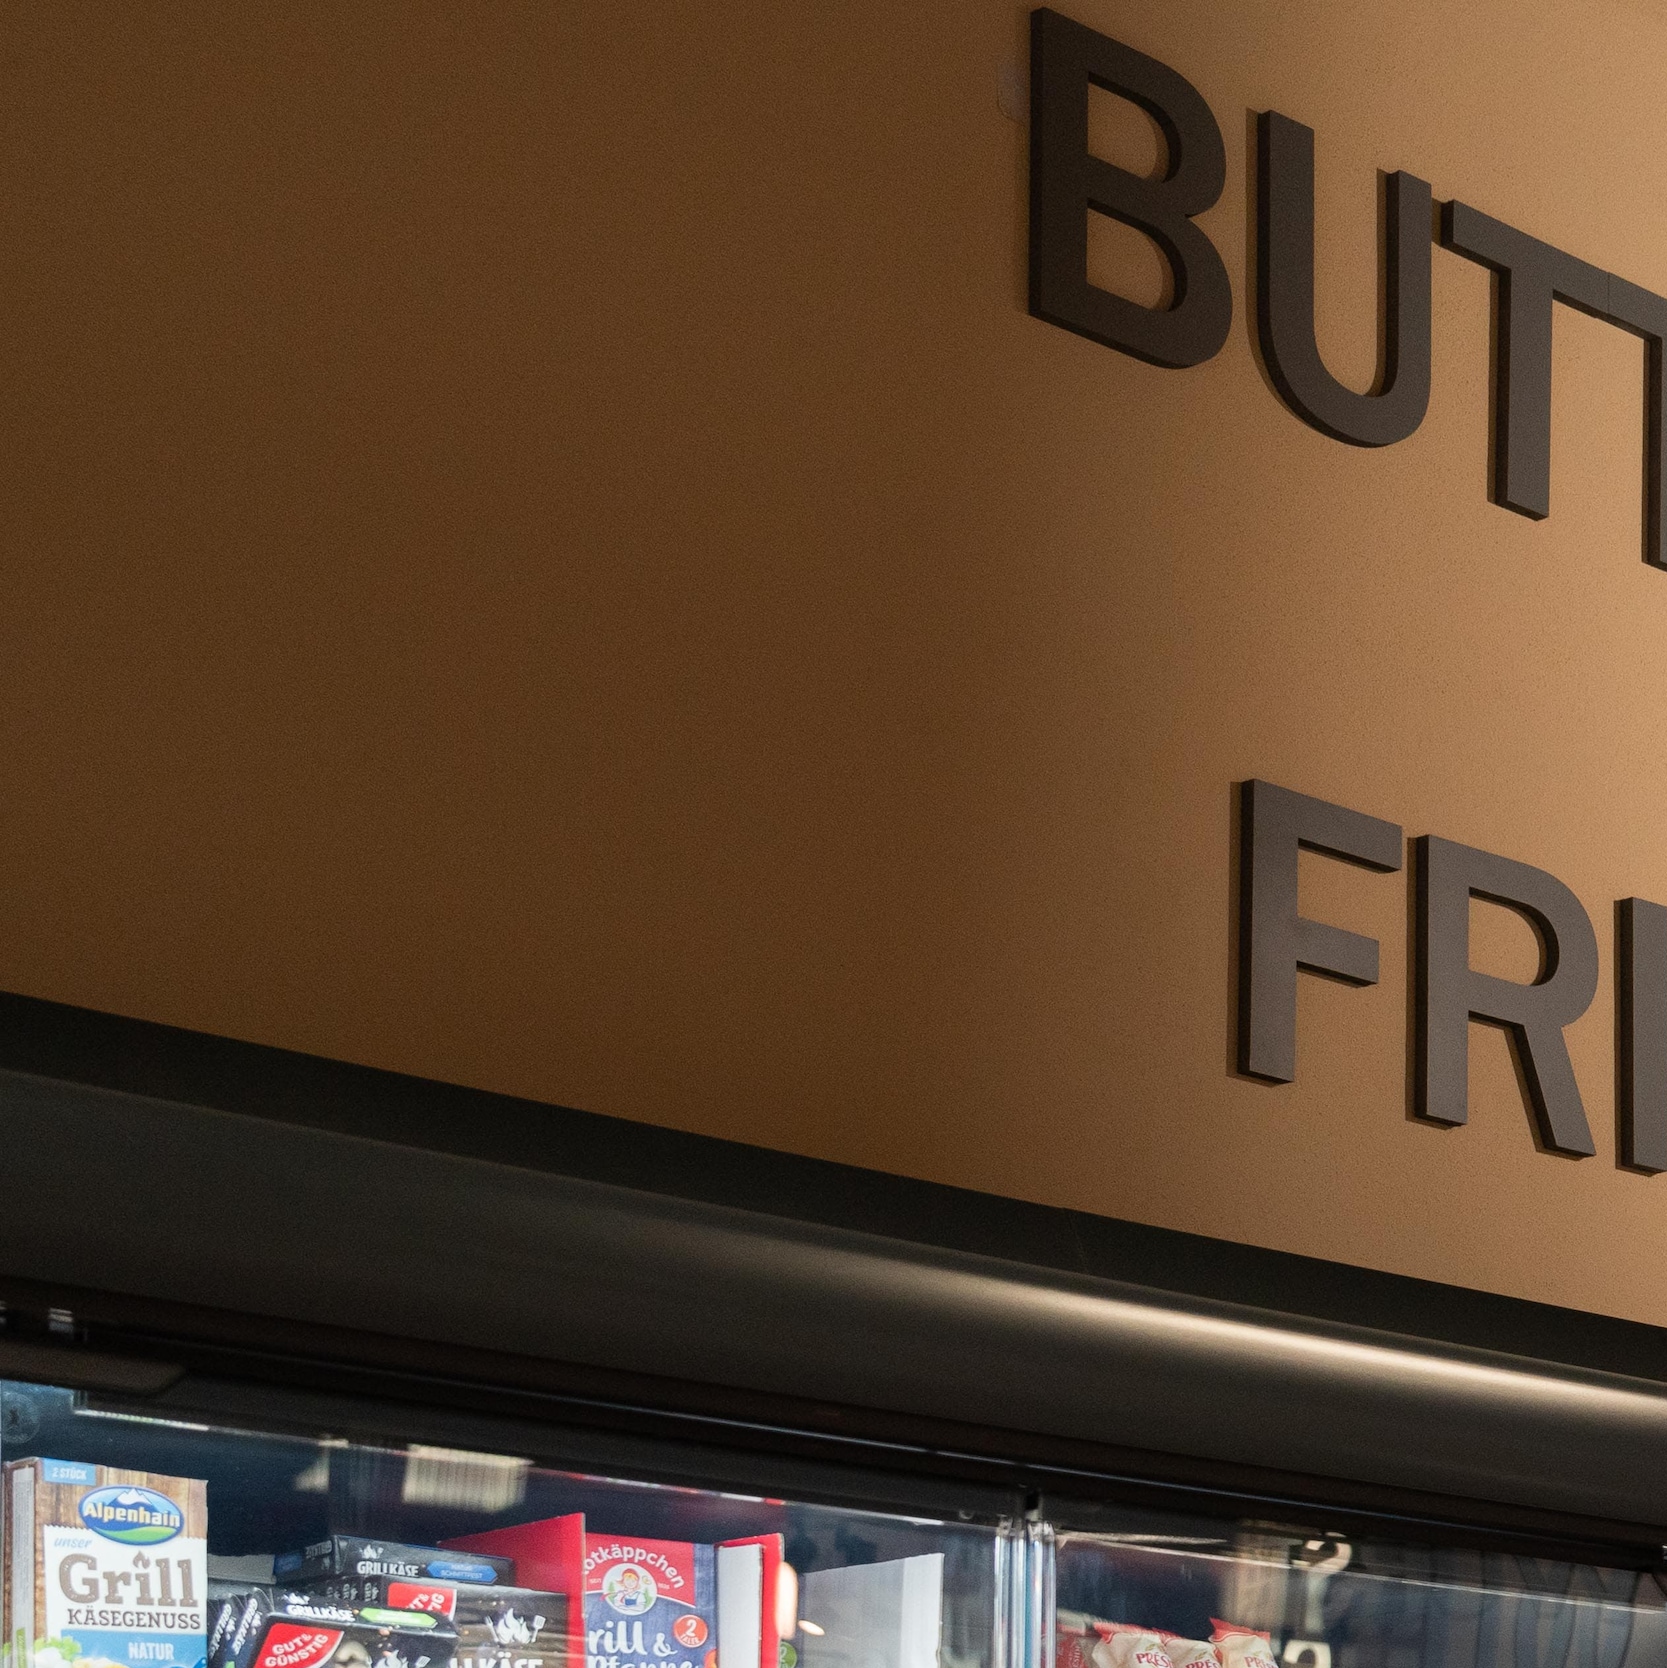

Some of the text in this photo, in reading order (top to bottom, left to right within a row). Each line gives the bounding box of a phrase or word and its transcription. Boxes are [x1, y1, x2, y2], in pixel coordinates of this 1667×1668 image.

[52, 1466, 87, 1481] 2 STÜCK
[83, 1502, 180, 1527] Alpenhain
[54, 1538, 91, 1549] unser
[357, 1560, 419, 1577] GRILLKÄSE
[59, 1550, 199, 1607] Grill
[67, 1606, 201, 1629] KÄSEGENUSS
[128, 1642, 174, 1660] NATUR
